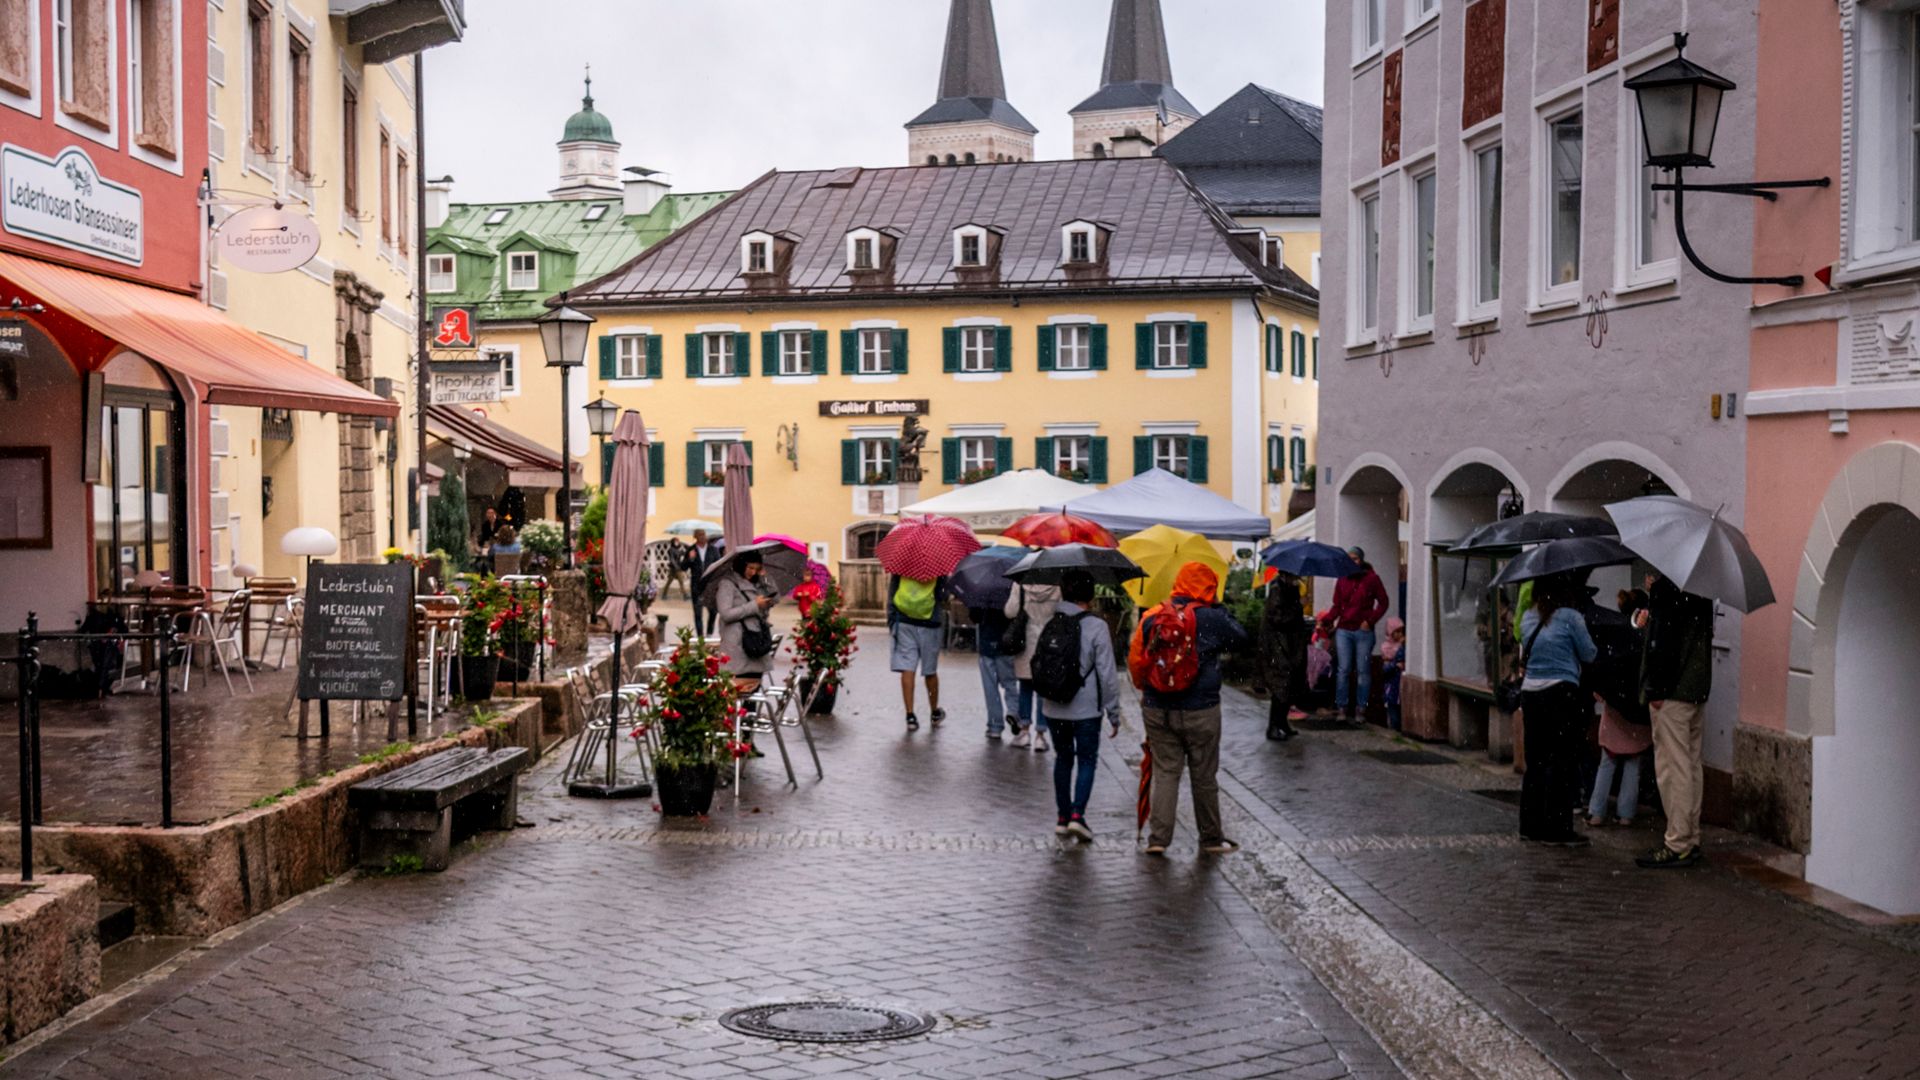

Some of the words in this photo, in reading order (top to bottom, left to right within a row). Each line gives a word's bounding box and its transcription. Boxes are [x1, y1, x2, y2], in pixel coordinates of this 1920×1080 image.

[10, 178, 71, 220] Lederhosen
[74, 198, 138, 240] Stangassinger
[226, 232, 311, 247] Lederstub'n
[0, 327, 22, 337] sen
[435, 375, 496, 390] Apotheke
[435, 393, 456, 402] am
[830, 401, 870, 415] Gasthof
[319, 577, 395, 594] Lederstub'n
[319, 604, 385, 616] MERCHANT
[326, 641, 381, 651] BIOTEAQUE
[319, 681, 359, 695] KUCHEN
